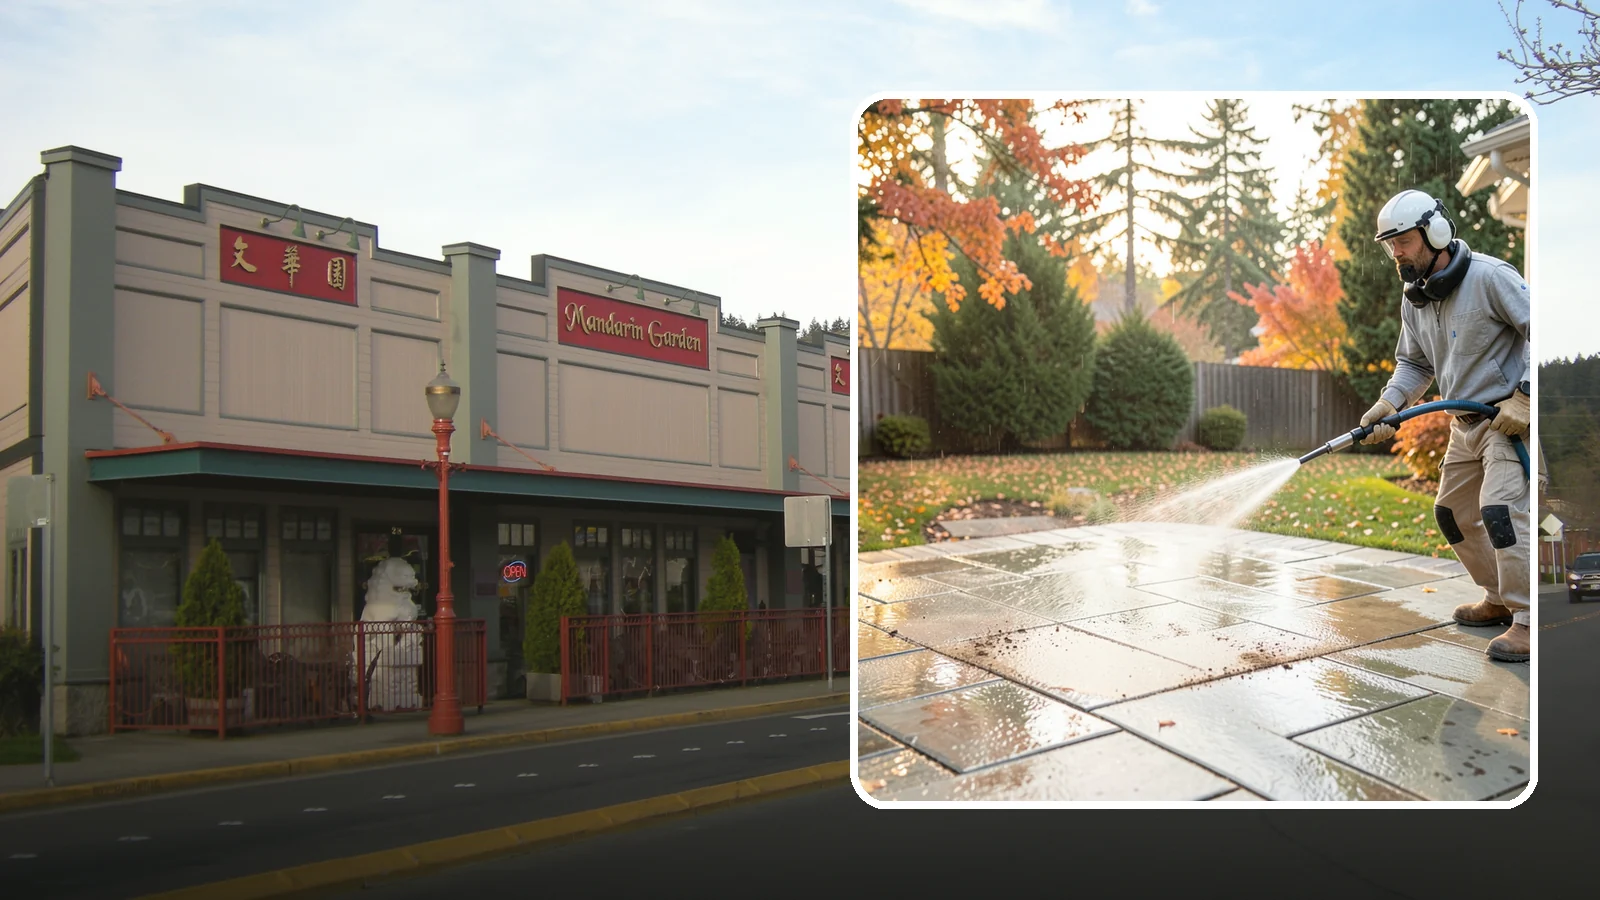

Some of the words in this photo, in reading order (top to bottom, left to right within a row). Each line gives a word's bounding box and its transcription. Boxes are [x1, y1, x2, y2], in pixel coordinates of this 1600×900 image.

[231, 235, 346, 291] 文華園
[564, 302, 644, 341] Mandarin
[647, 320, 702, 352] Garden
[834, 363, 847, 386] 文
[503, 565, 527, 578] OPEN
